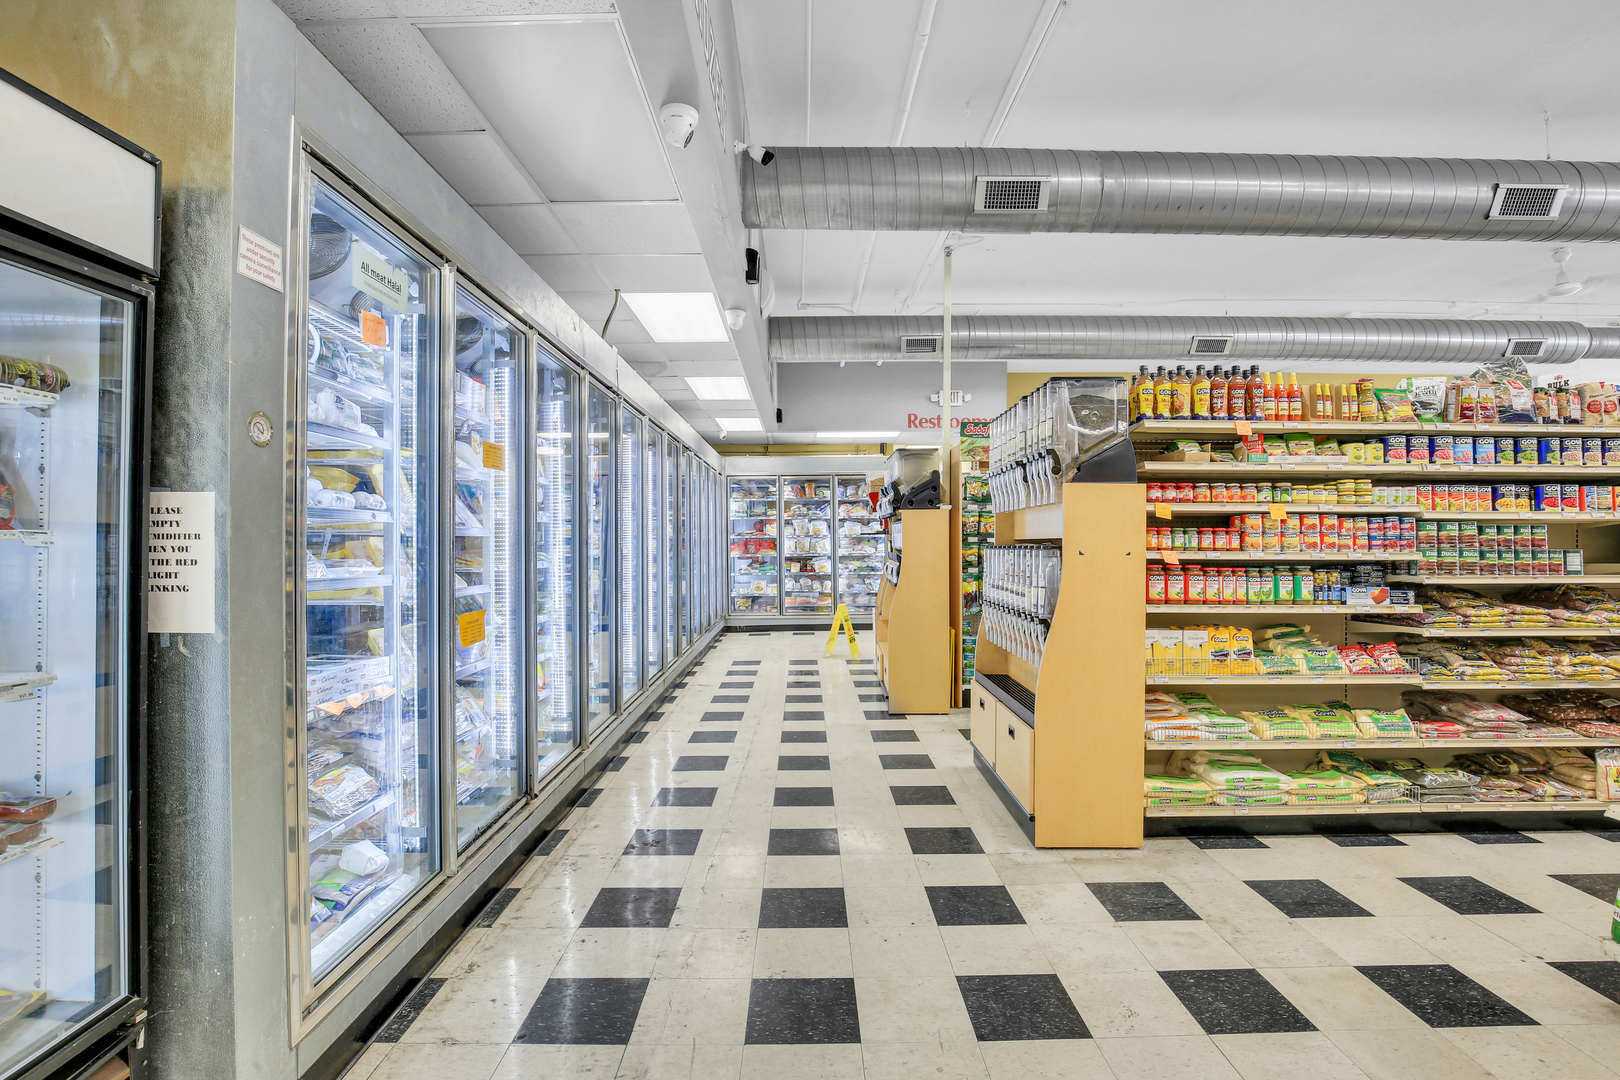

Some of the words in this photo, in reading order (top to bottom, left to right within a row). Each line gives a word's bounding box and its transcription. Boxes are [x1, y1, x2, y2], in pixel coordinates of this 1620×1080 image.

[242, 233, 254, 245] These
[254, 242, 273, 255] premises
[240, 252, 256, 264] camera
[256, 261, 282, 276] surveillance
[246, 247, 259, 256] under
[259, 253, 276, 266] security
[252, 268, 262, 276] your
[262, 272, 276, 283] safety
[361, 261, 370, 273] All
[370, 268, 386, 284] meat
[388, 278, 402, 293] Halal
[1548, 380, 1570, 388] BULK
[908, 414, 996, 429] Resto
